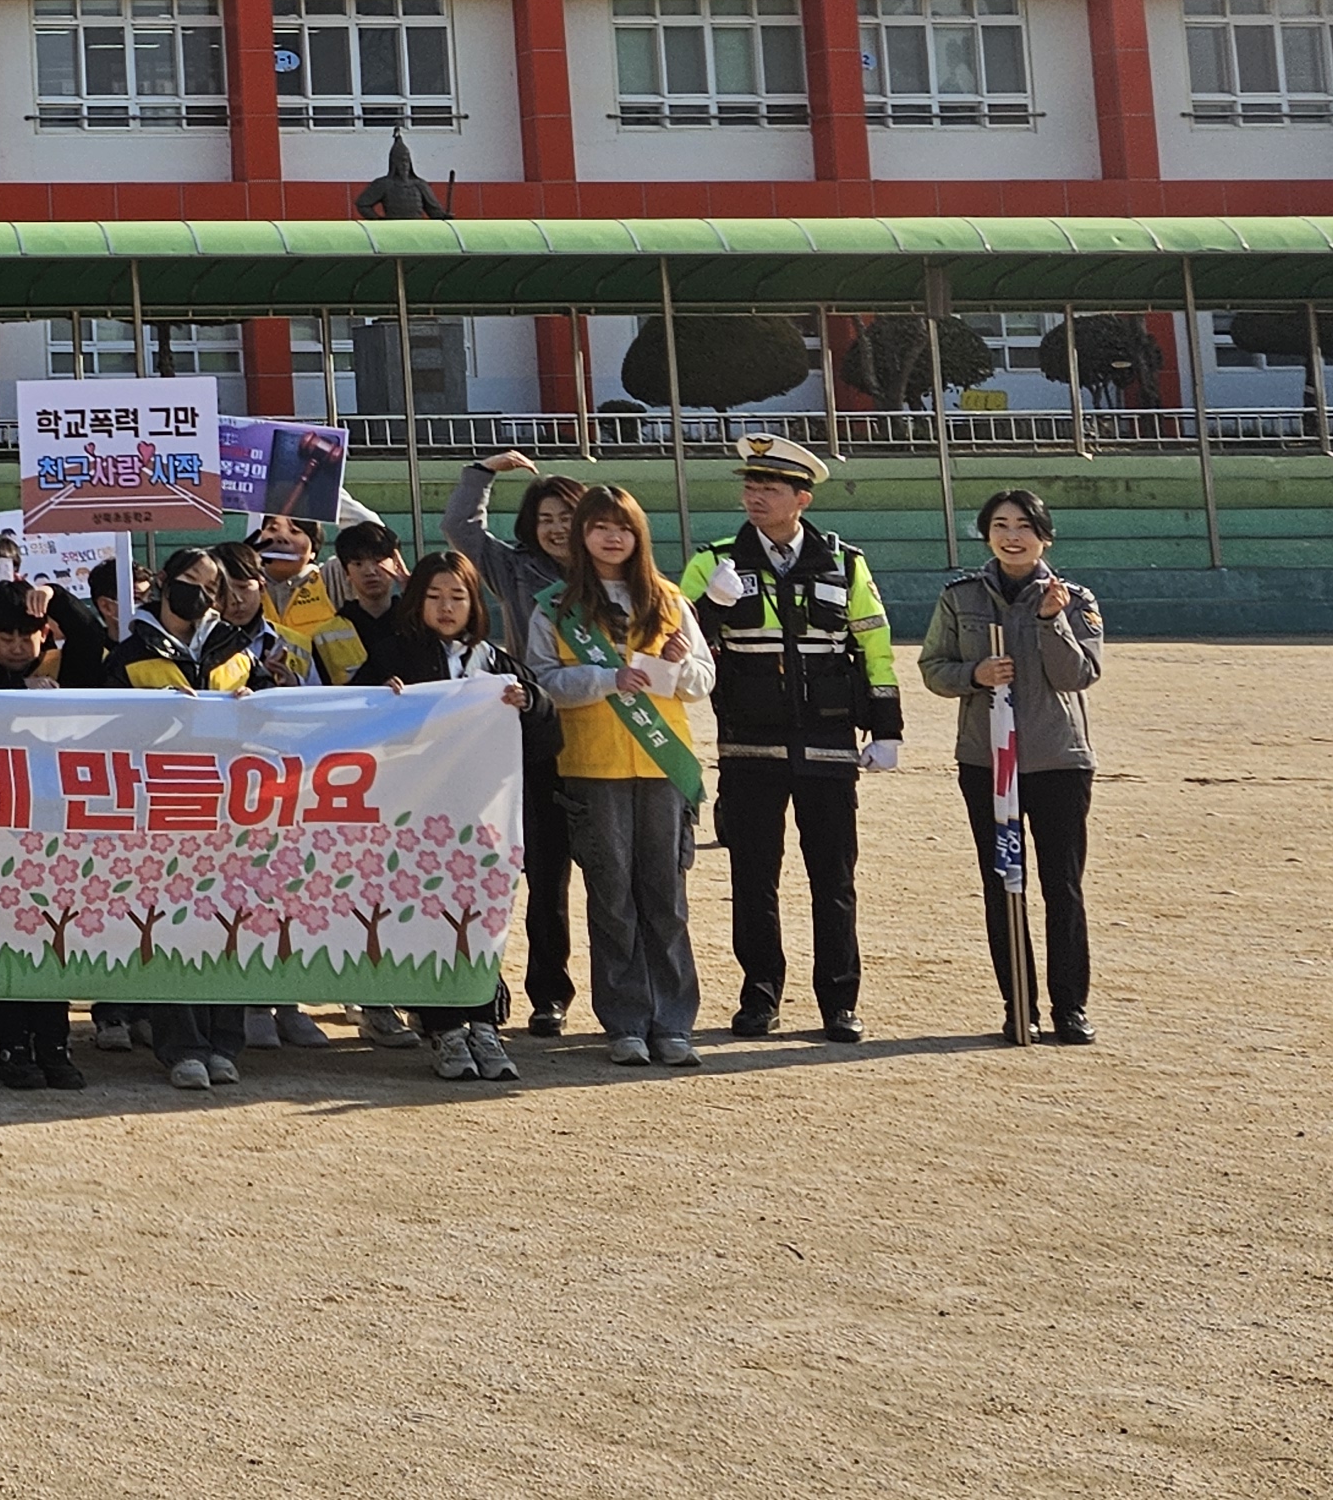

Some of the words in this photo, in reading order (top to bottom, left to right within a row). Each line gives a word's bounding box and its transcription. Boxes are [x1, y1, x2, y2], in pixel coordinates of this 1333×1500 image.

[36, 407, 139, 440] 학교폭력
[148, 406, 199, 437] 그만
[36, 453, 143, 490] 친구사랑
[149, 452, 203, 486] 시작
[92, 511, 153, 524] 상북초등학교
[57, 750, 381, 832] 만들어요
